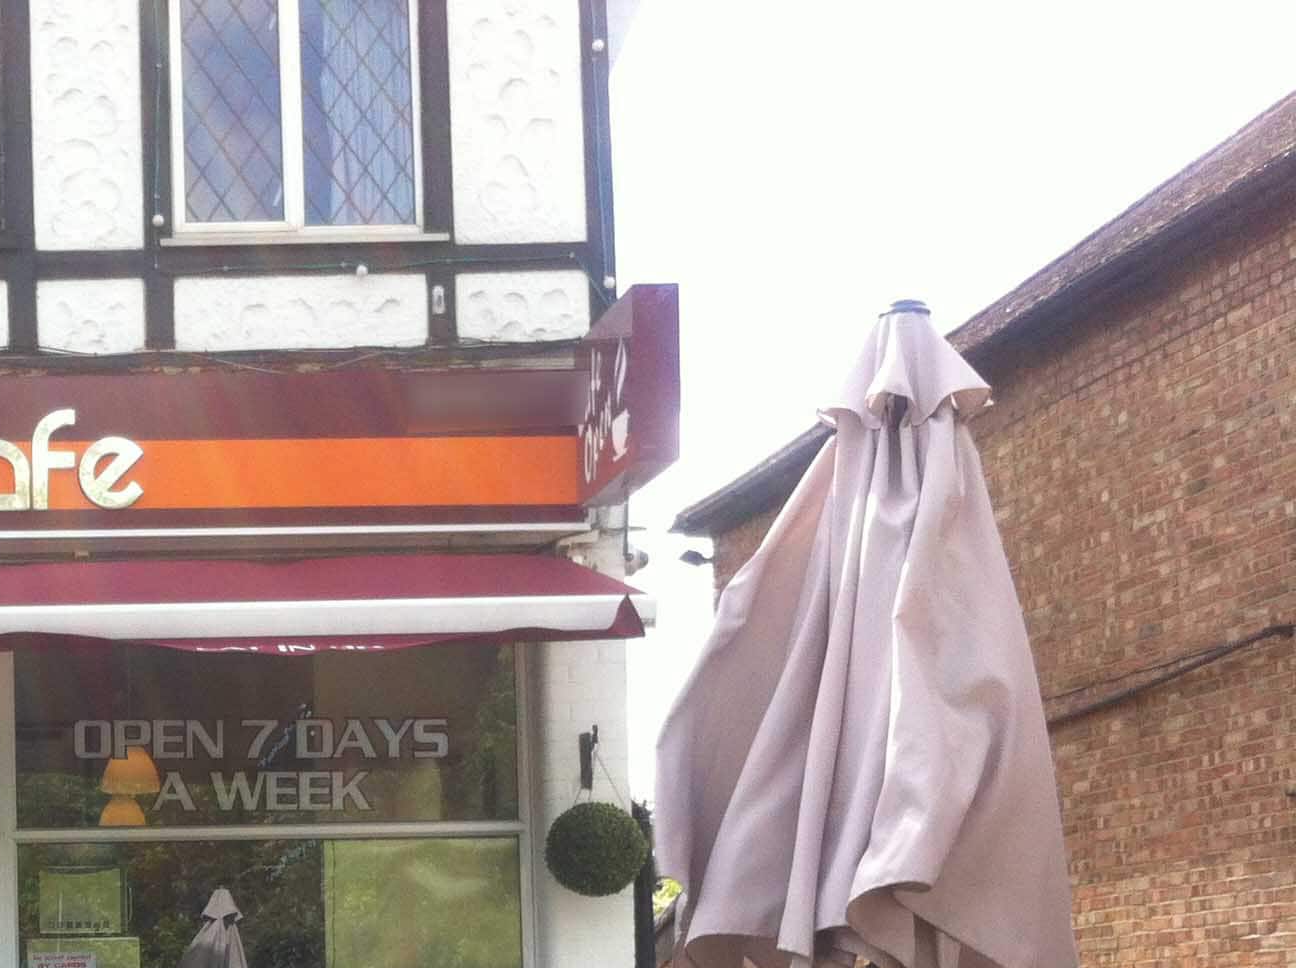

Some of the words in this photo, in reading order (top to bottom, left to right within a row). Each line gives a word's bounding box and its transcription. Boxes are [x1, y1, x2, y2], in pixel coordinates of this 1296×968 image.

[74, 719, 224, 760] OPEN
[241, 720, 278, 759] 7
[296, 719, 449, 759] DAYS
[152, 771, 197, 811] A
[211, 771, 376, 811] WEEK
